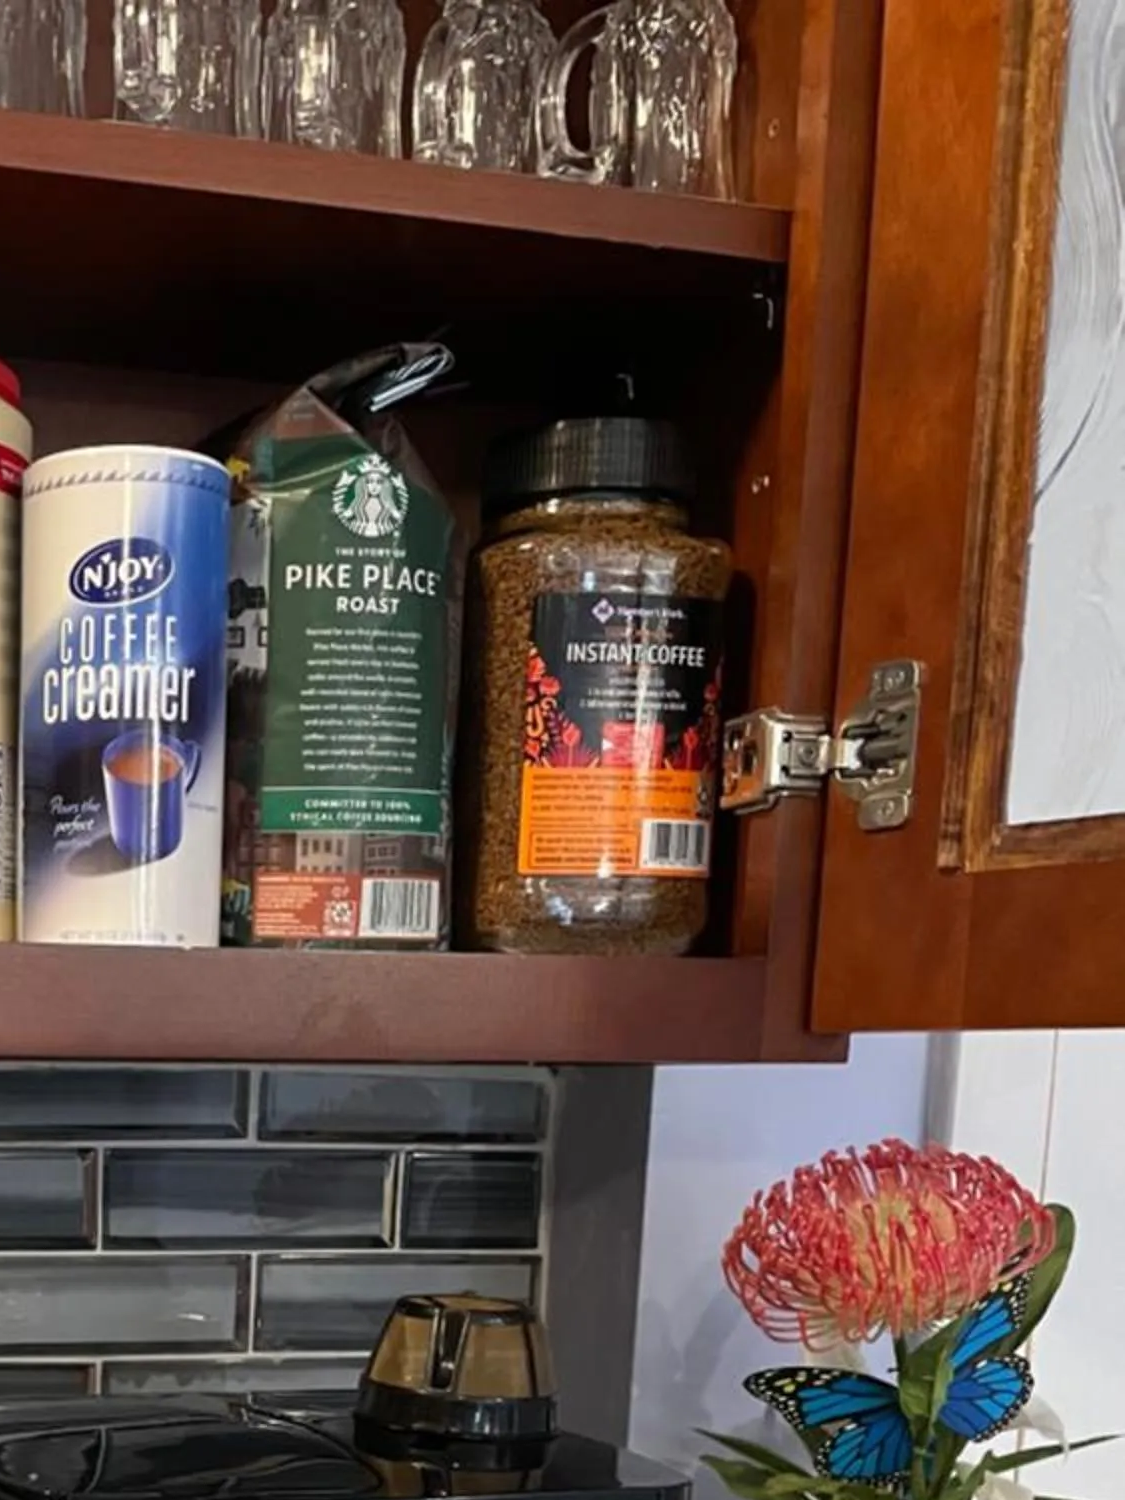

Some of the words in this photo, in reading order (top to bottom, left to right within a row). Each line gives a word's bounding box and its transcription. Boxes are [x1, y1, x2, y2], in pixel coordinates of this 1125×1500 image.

[285, 563, 352, 591] PIKE
[363, 563, 437, 597] PLACE
[336, 595, 401, 615] ROAST
[60, 612, 178, 665] COFFEE
[566, 642, 645, 665] INSTANT
[648, 644, 706, 668] COFFEE
[43, 662, 197, 725] creamer
[53, 814, 96, 838] perfect
